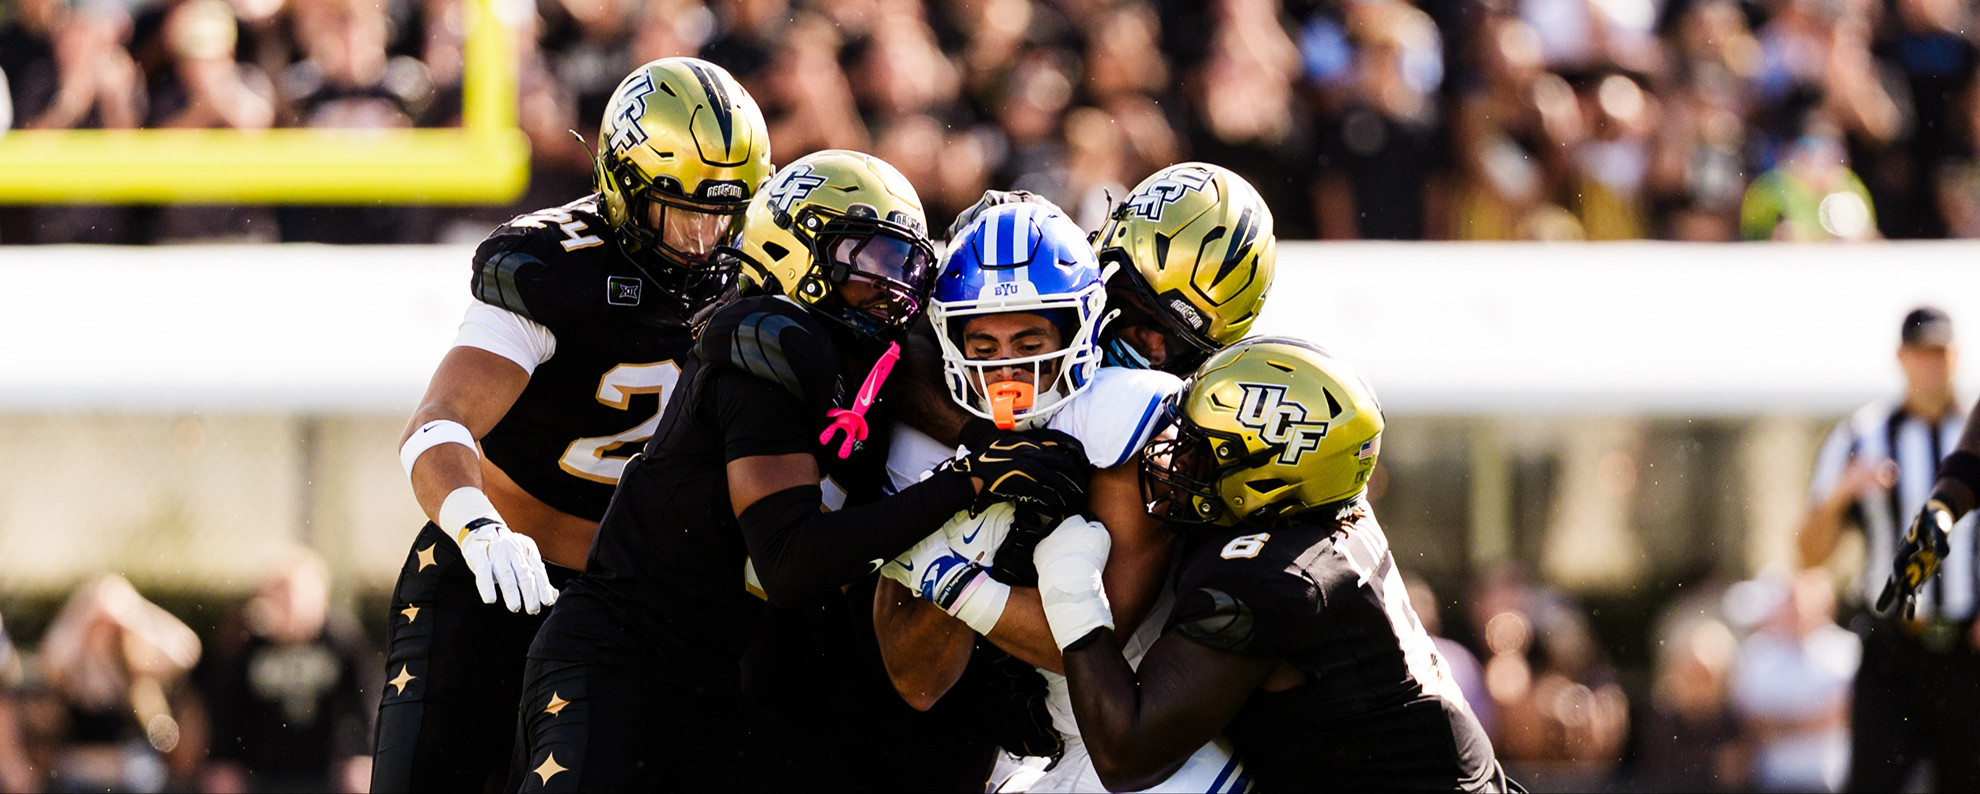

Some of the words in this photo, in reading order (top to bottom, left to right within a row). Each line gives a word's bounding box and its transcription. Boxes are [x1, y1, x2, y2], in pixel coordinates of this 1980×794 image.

[609, 68, 656, 155] UCF
[769, 163, 829, 214] CF
[1126, 167, 1216, 223] UCF
[994, 283, 1018, 296] BYU
[1234, 377, 1330, 467] UCF
[1220, 532, 1271, 560] 6
